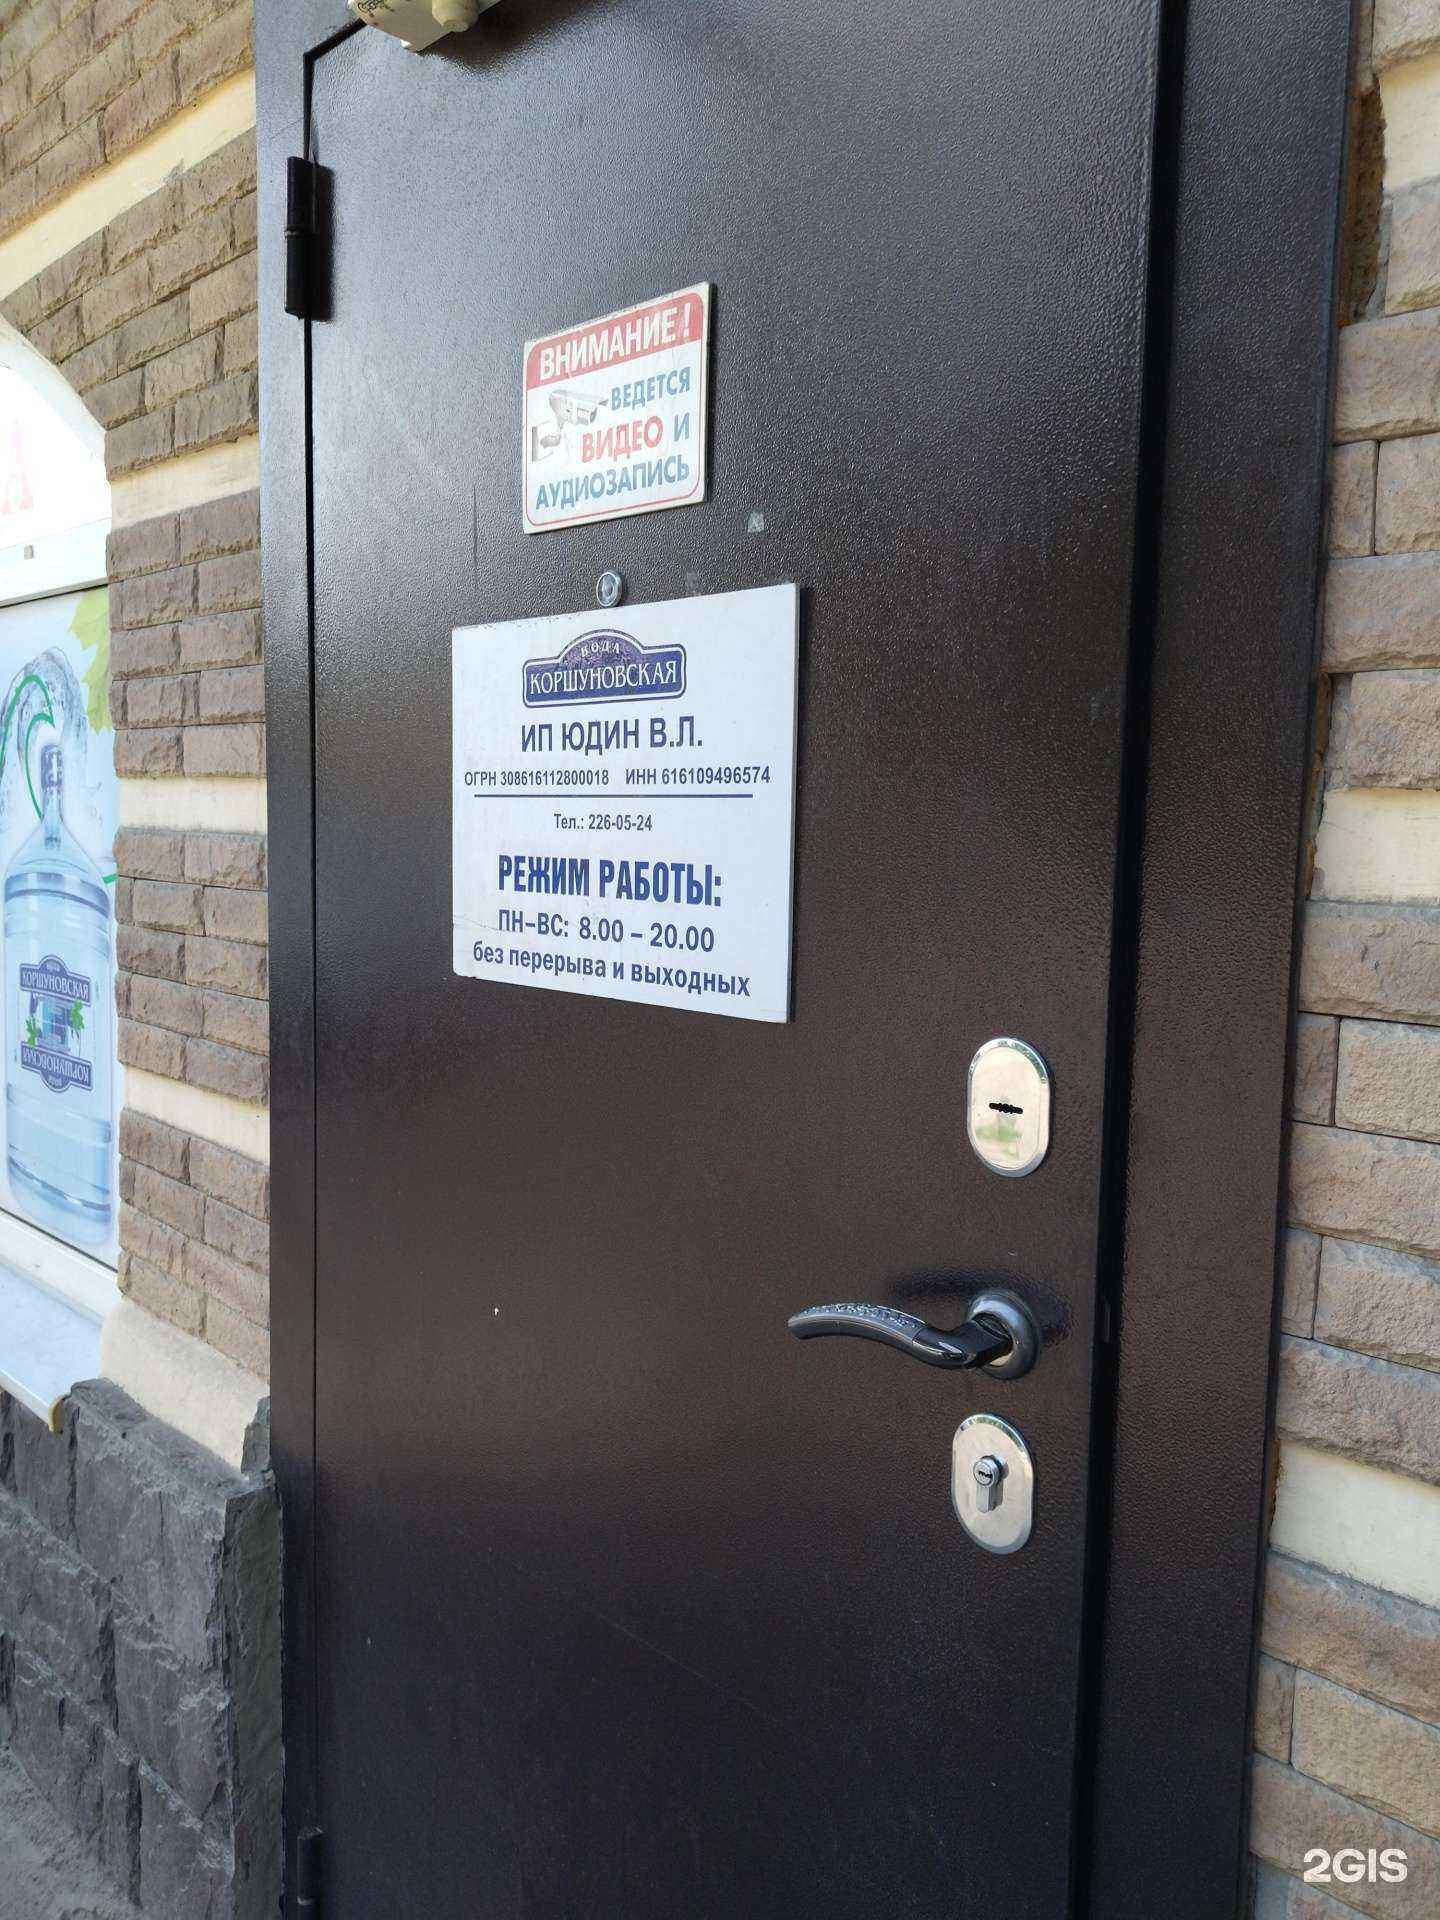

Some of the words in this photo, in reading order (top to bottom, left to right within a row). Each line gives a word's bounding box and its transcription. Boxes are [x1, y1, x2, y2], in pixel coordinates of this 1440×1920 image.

[611, 367, 691, 411] ВЕДЕТСЯ
[582, 415, 664, 463] ВИДЕО
[674, 412, 690, 442] И
[536, 454, 690, 510] АУДИОЗАПИСЬ
[530, 660, 677, 695] КОРШУНОВСКАЯ
[521, 723, 553, 752] ИП
[562, 718, 639, 756] ЮДИН
[650, 716, 703, 748] В.Л.
[464, 771, 496, 786] ОГРН
[500, 770, 609, 786] 308616112800018
[625, 769, 657, 785] ИНН
[661, 766, 770, 784] 616109496574
[554, 814, 585, 830] Тел.:
[588, 814, 653, 831] 226-05-24
[499, 854, 589, 896] РЕЖИМ
[599, 859, 722, 906] РАБОТЫ:
[579, 916, 624, 943] 8.00
[650, 922, 714, 952] 20.00
[473, 941, 504, 964] без
[509, 949, 606, 978] перерыва
[613, 963, 624, 979] и
[631, 964, 750, 996] выходных
